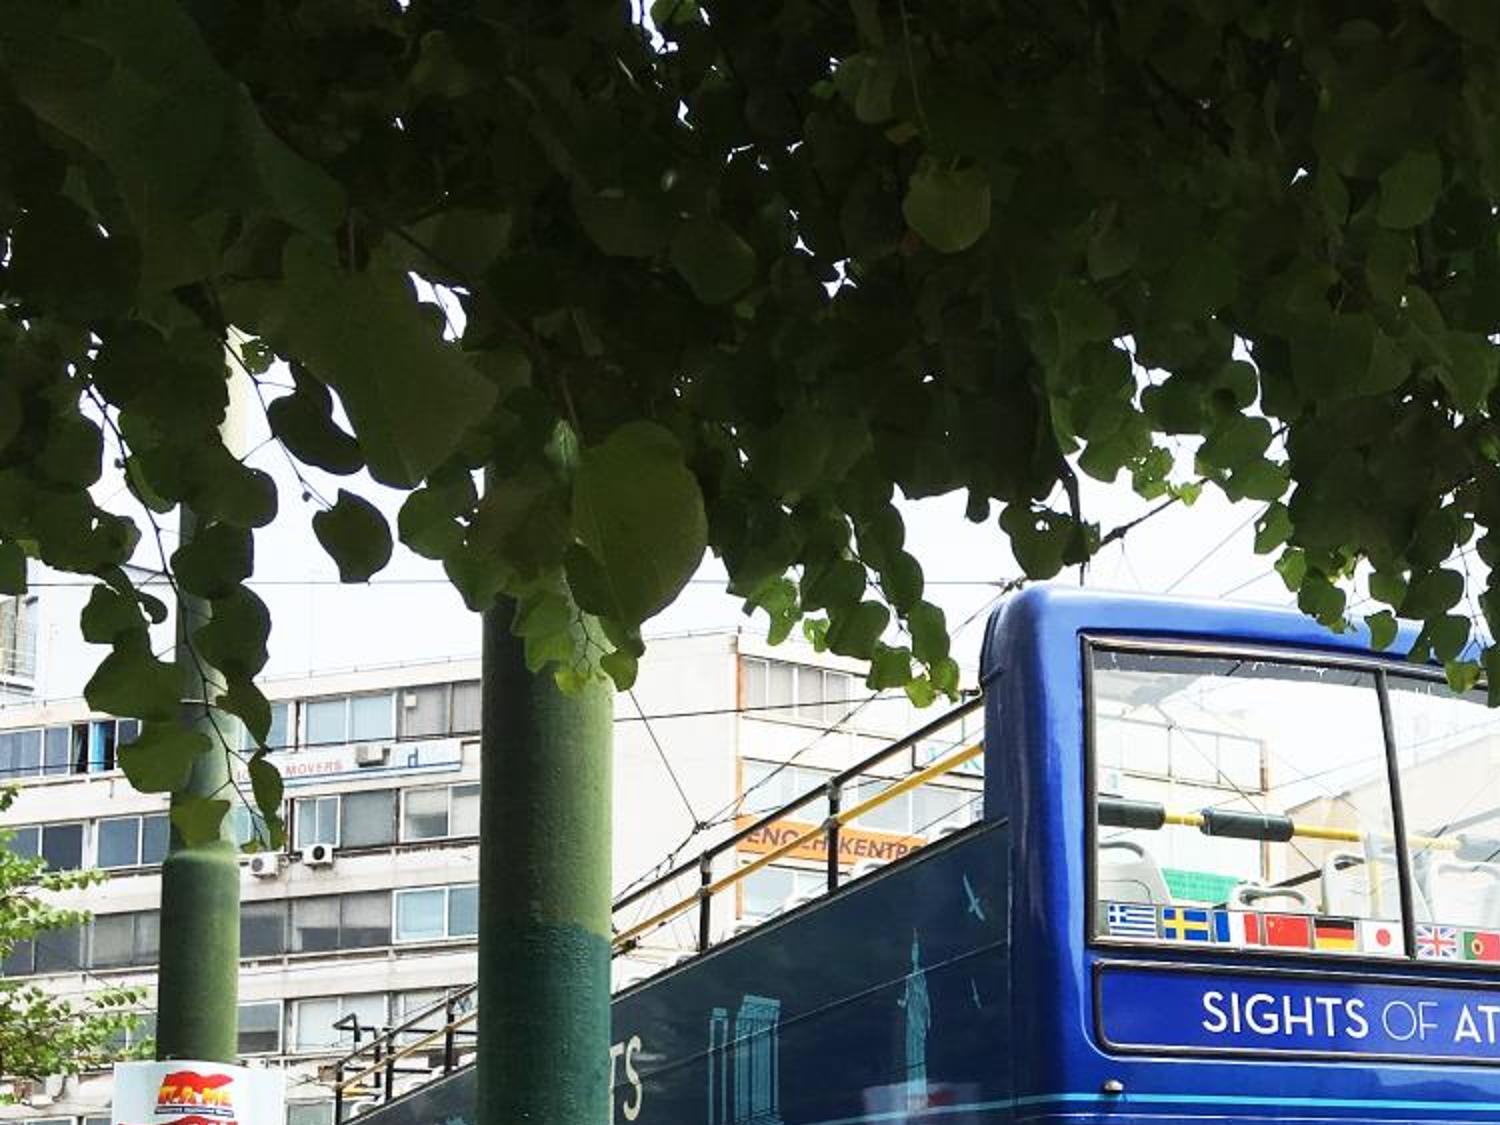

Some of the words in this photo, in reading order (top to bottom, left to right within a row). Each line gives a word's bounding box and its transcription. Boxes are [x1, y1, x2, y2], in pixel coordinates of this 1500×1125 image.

[286, 760, 344, 776] MOVERS
[1202, 991, 1370, 1040] SIGHTS
[1382, 1001, 1439, 1041] OF
